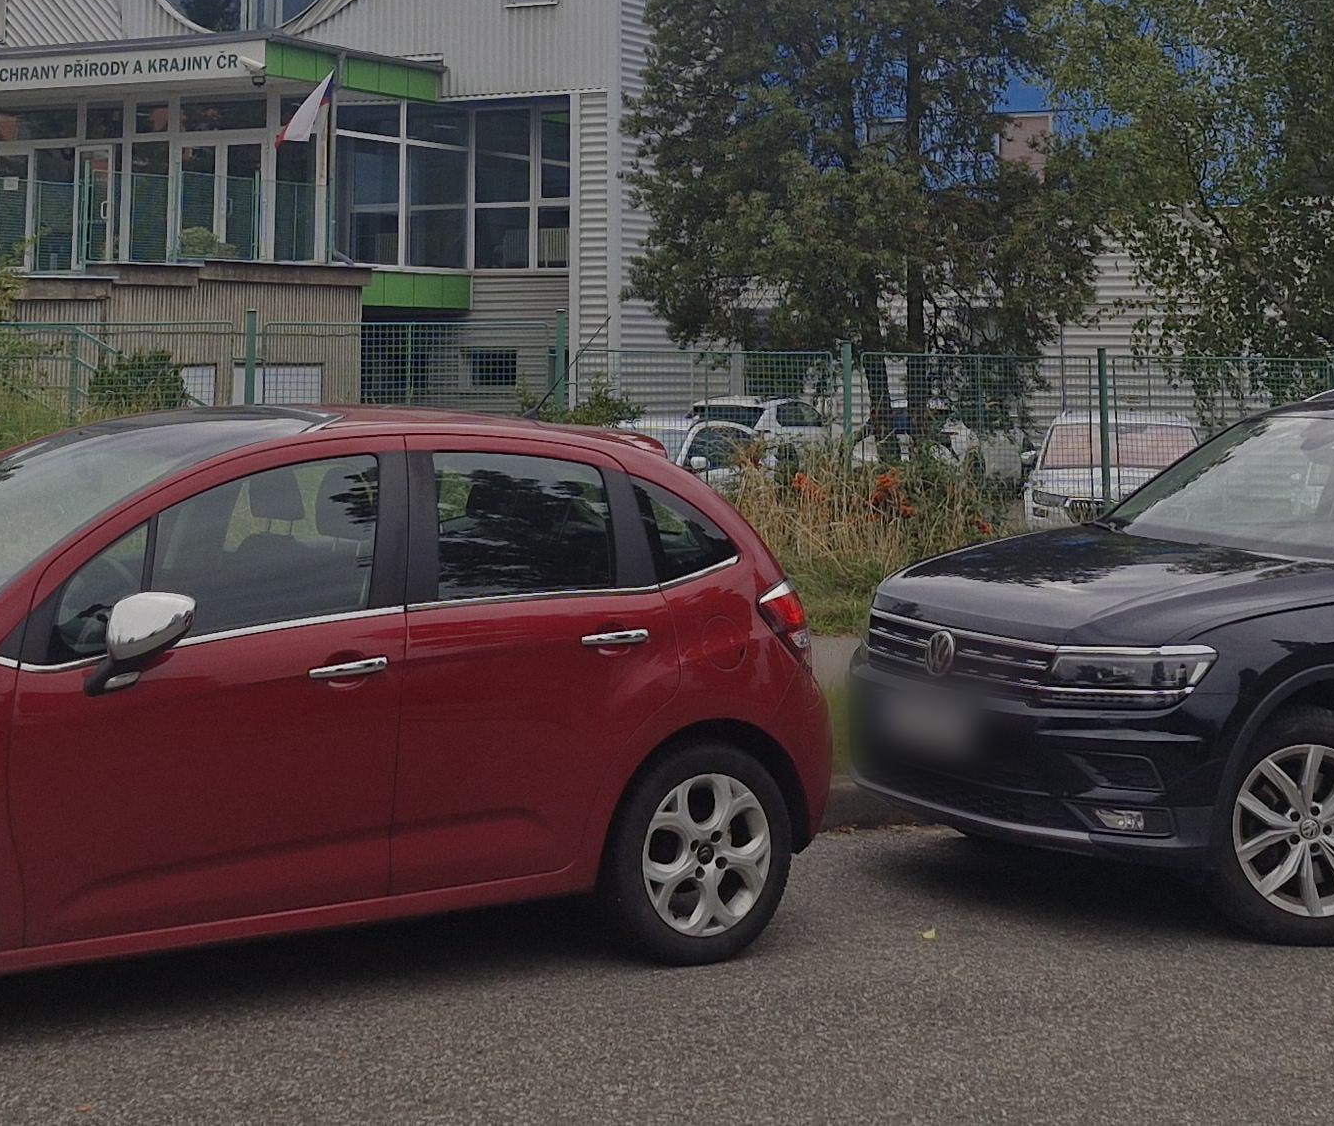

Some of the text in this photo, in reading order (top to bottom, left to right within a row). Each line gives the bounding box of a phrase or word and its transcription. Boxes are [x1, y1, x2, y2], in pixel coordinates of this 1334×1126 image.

[63, 59, 129, 79] PŘÍRODY
[133, 60, 143, 74] A
[148, 55, 212, 73] KRAJINY
[216, 50, 238, 69] ČR
